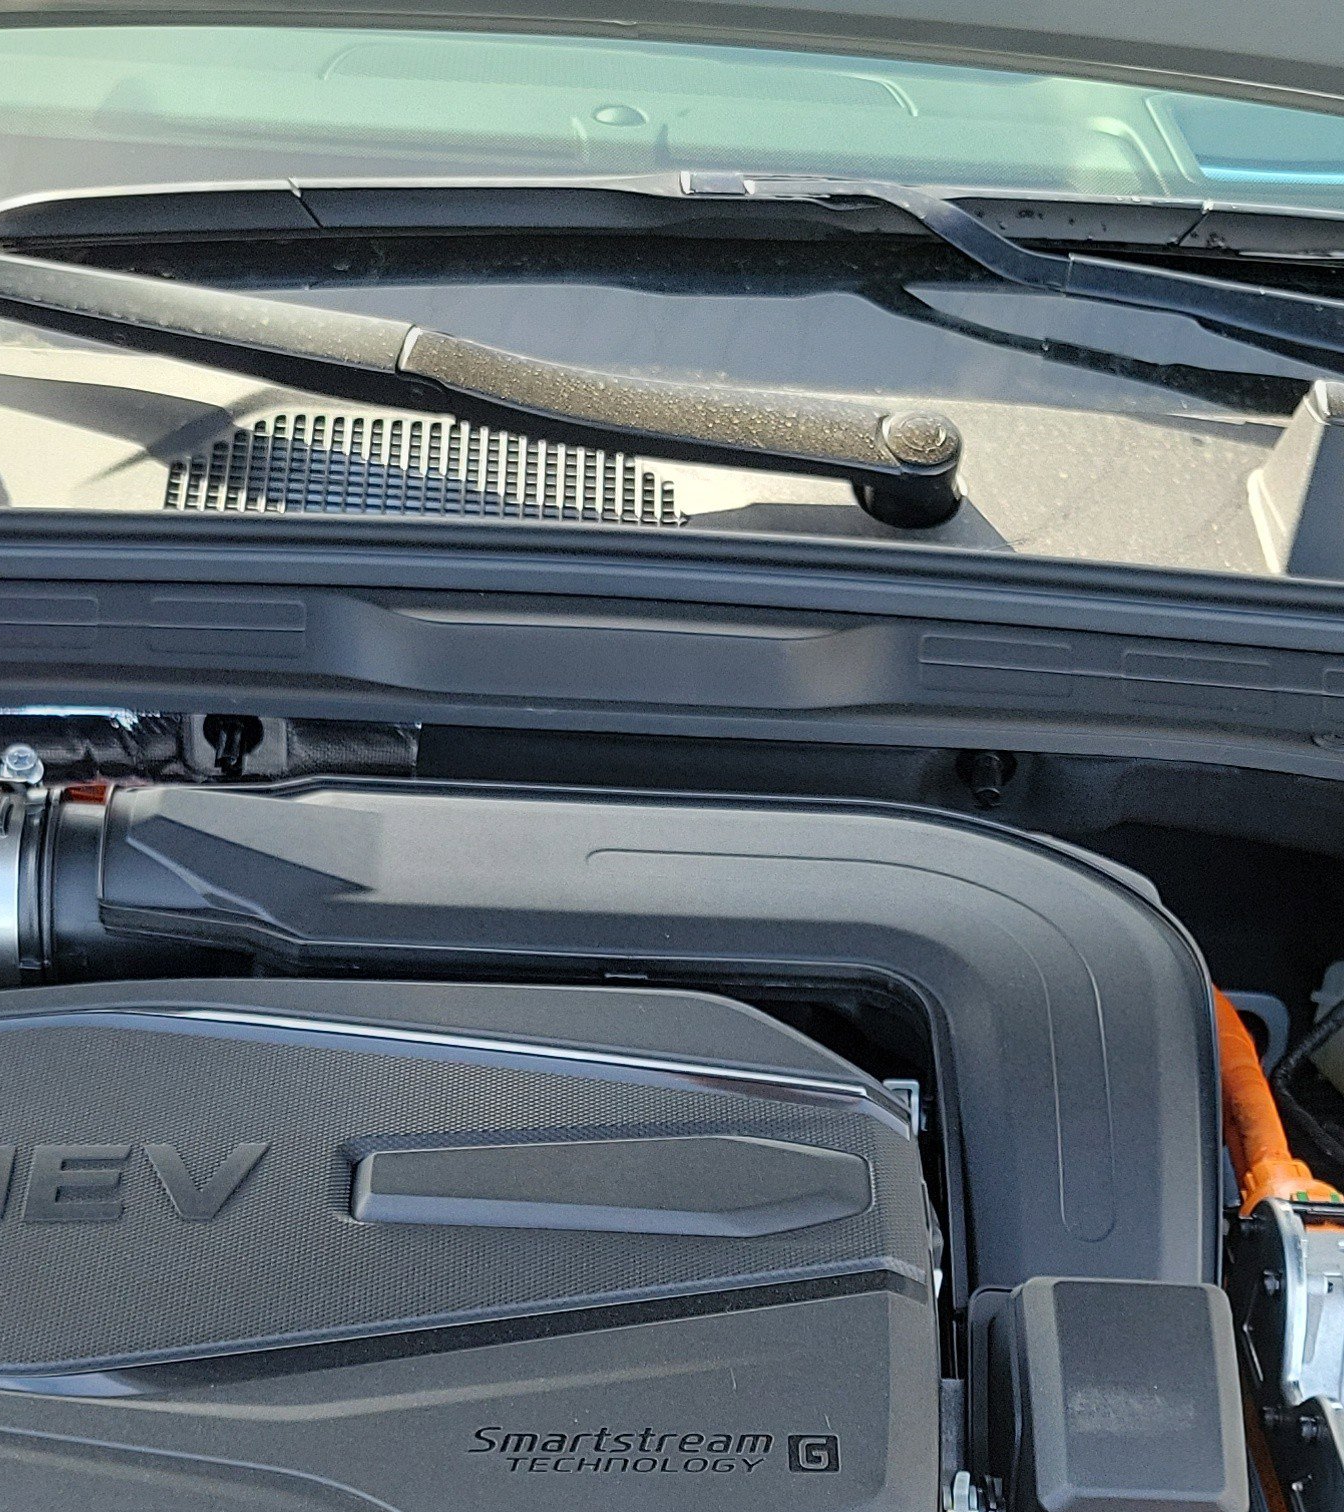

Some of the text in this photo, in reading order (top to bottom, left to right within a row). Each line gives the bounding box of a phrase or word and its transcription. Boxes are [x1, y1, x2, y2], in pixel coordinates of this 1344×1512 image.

[467, 1425, 834, 1471] Smartstream G
[505, 1457, 765, 1473] TECHNOLOGY
